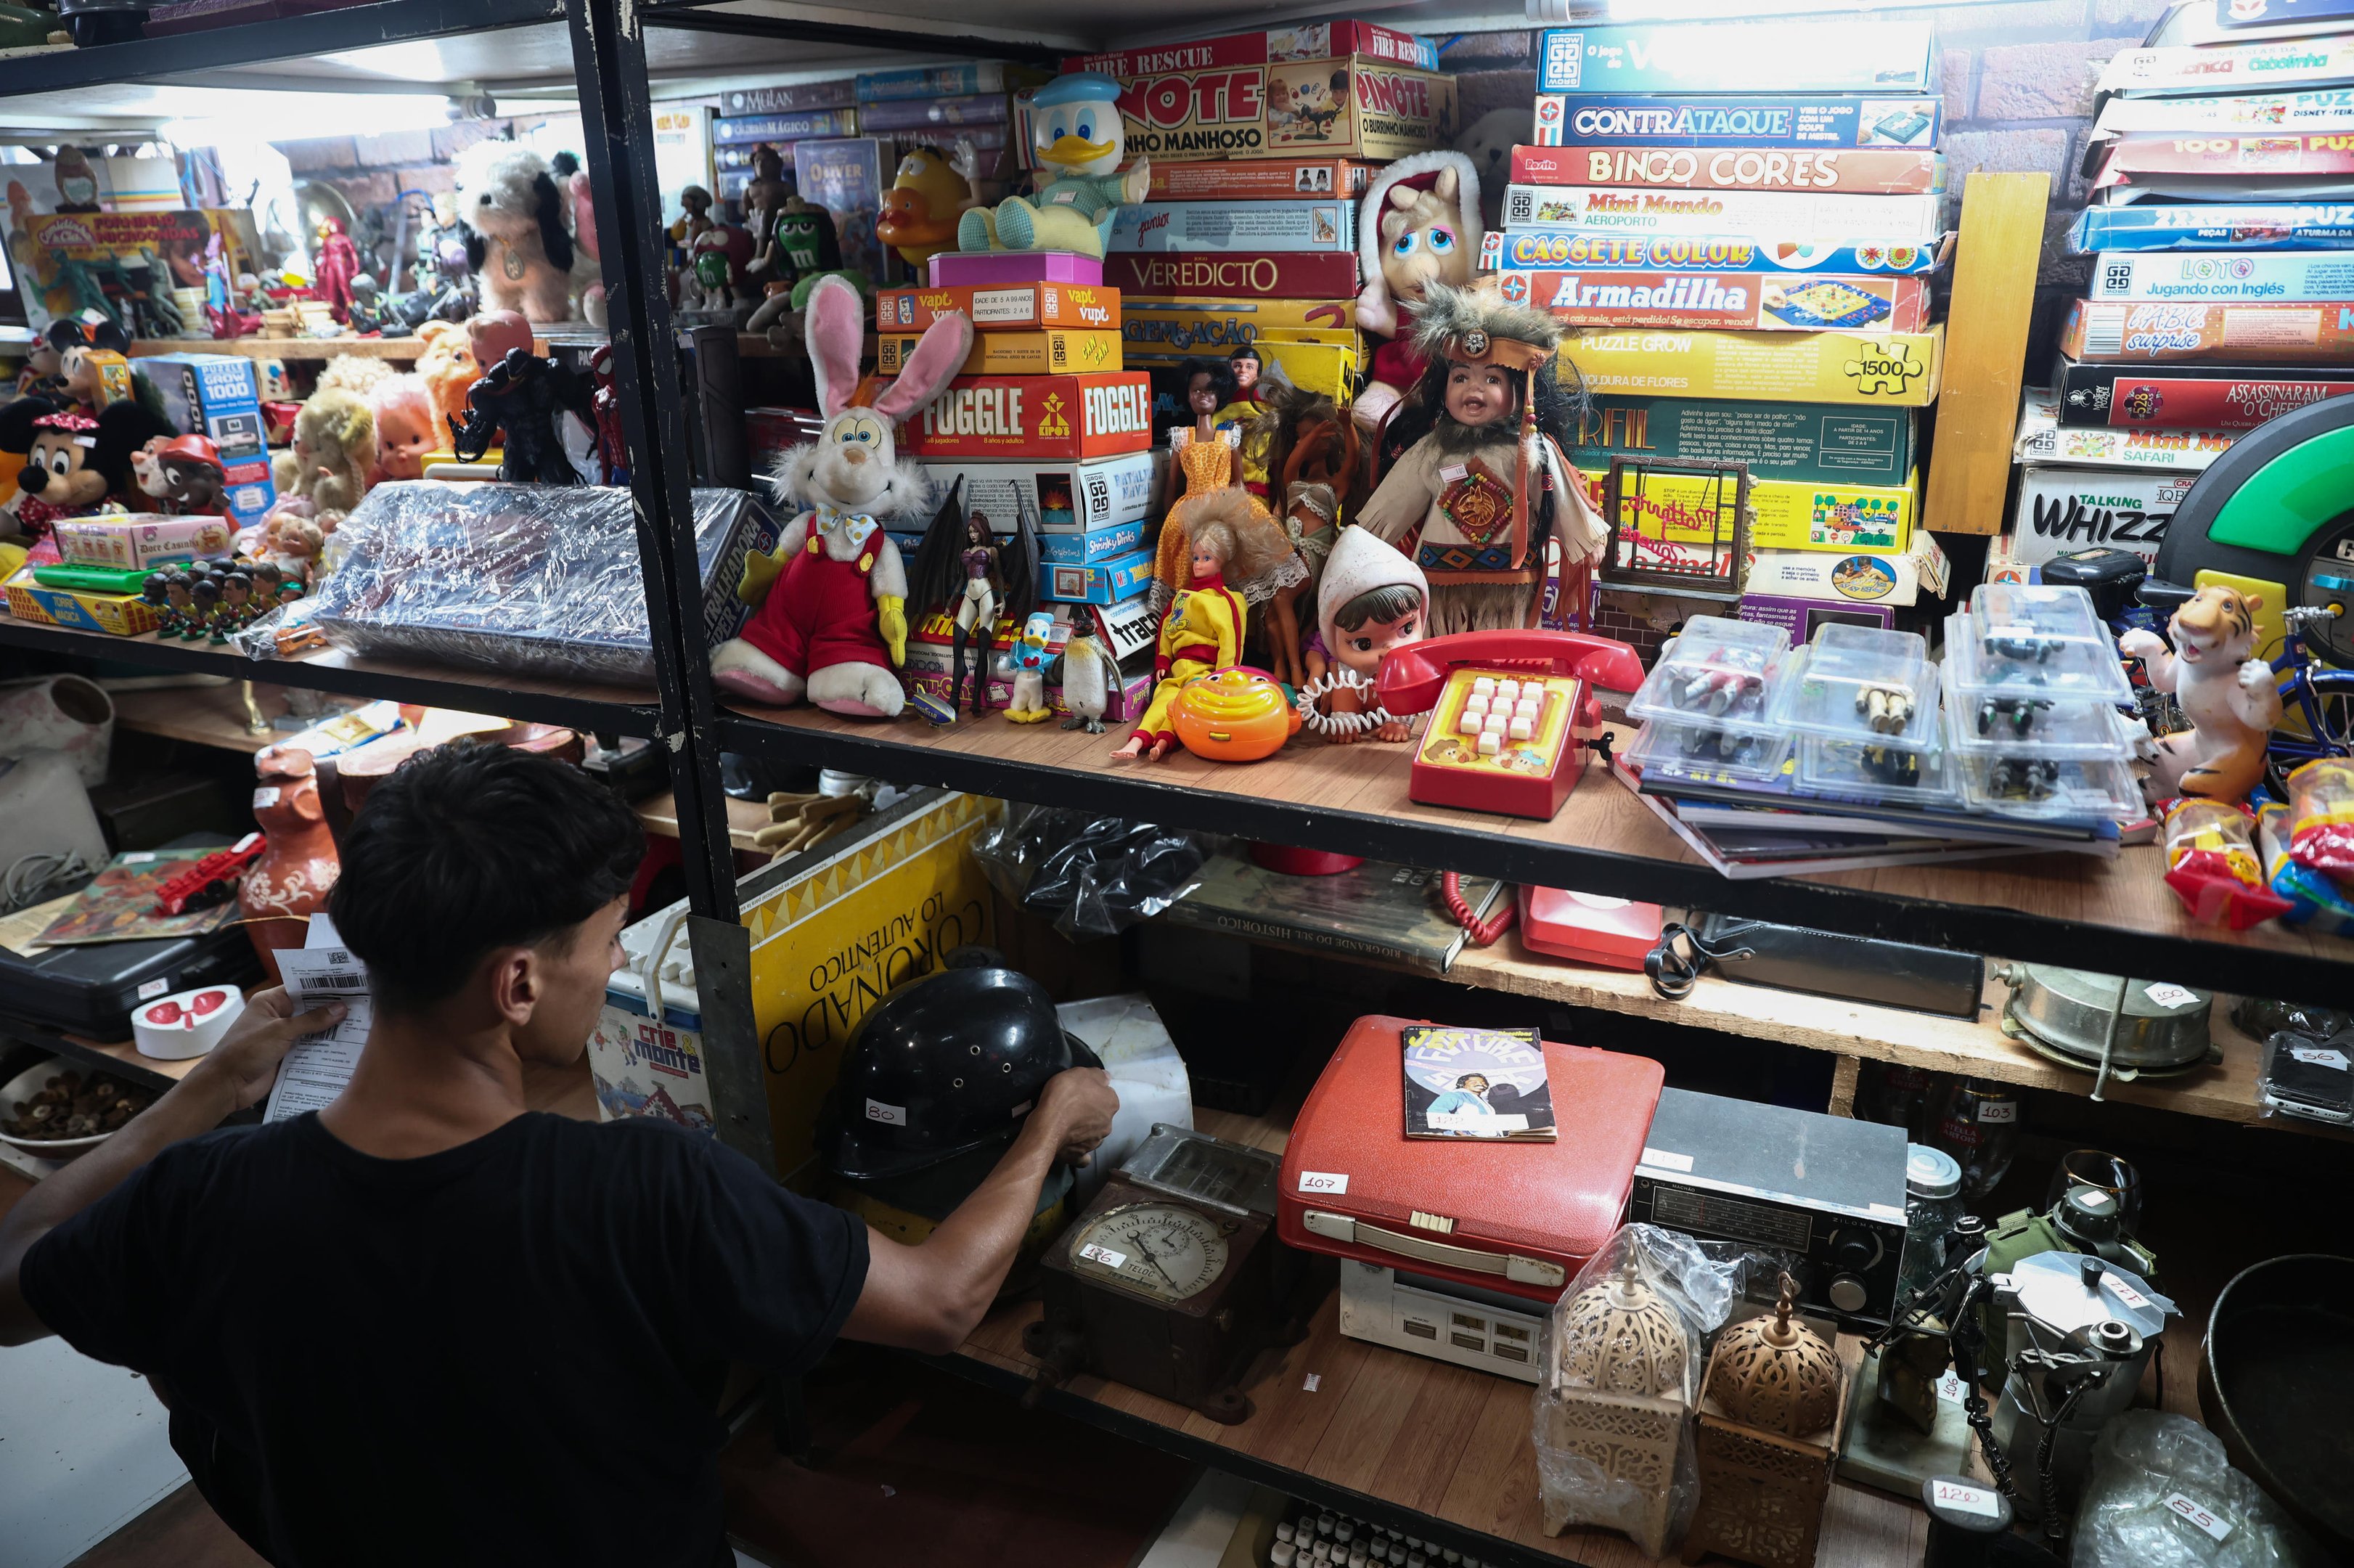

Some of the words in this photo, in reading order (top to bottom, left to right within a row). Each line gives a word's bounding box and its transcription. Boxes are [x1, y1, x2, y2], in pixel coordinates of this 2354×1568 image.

[1373, 36, 1395, 58] FIRE
[1398, 41, 1429, 65] RESCUE
[1137, 46, 1213, 73] RESCUE
[1356, 69, 1431, 121] PINOTE
[1369, 120, 1399, 136] BURRINHO
[1399, 123, 1427, 139] MANHOSO
[1165, 128, 1262, 151] MANHOSO
[1525, 160, 1556, 171] Rosita
[1587, 150, 1698, 182] BINGO
[1708, 152, 1839, 187] CORES
[1585, 193, 1639, 213] Mini
[1641, 195, 1723, 216] Mundo
[1585, 215, 1656, 226] AEROPORTO
[2199, 229, 2227, 238] PEÇAS
[1516, 238, 1643, 264] CASSETE
[1650, 239, 1754, 265] COLOR
[1129, 258, 1278, 291] VEREDICTO
[2181, 258, 2255, 279] LOTO
[1552, 277, 1746, 310] Armadilha
[2146, 282, 2208, 297] Jugando
[2211, 284, 2239, 295] con
[2241, 282, 2285, 297] Inglés
[919, 292, 952, 312] vapt
[1068, 288, 1096, 309] vapt
[1079, 306, 1109, 325] vupt
[1587, 315, 1611, 324] nela,
[1632, 315, 1669, 325] perdido!
[1670, 315, 1681, 325] Se
[1683, 317, 1722, 326] escapar,
[1724, 317, 1754, 326] vence!
[1082, 335, 1096, 360] CAN
[1094, 340, 1109, 365] CAN
[1581, 335, 1639, 351] PUZZLE
[1642, 337, 1692, 353] GROW
[2128, 332, 2199, 356] surprise
[202, 363, 243, 375] PUZZLE
[1860, 362, 1903, 376] 1500
[204, 372, 245, 385] GROW
[1632, 376, 1646, 386] DE
[1647, 377, 1688, 388] FLORES
[205, 383, 249, 399] 1000
[2101, 385, 2110, 409] PUZZLE
[183, 371, 203, 433] 1000
[1084, 384, 1149, 436] FOGGLE
[2133, 392, 2149, 415] 528
[923, 388, 1025, 436] FOGGLE
[1039, 425, 1070, 436] KIPO'S
[2124, 429, 2189, 450] Mini
[2123, 451, 2175, 462] SAFARI
[2080, 494, 2143, 509] TALKING
[1092, 513, 1110, 522] GROW
[139, 544, 161, 553] Doce
[1089, 536, 1116, 555] Shrinky
[1116, 533, 1135, 547] Dinks
[1087, 569, 1095, 580] 3
[1115, 572, 1128, 587] MB
[52, 596, 74, 609] TORRE
[922, 891, 943, 922] LO
[1295, 930, 1314, 941] SUL
[1316, 934, 1333, 945] DO
[1335, 938, 1380, 954] GRANDE
[1381, 947, 1401, 958] RIO
[2157, 989, 2183, 1001] 100
[638, 1023, 677, 1050] crie
[1408, 1030, 1466, 1049] JET
[867, 1106, 894, 1120] 80
[1982, 1107, 2011, 1119] 103
[1944, 1131, 1976, 1143] ARTOIS
[1945, 1122, 1977, 1137] STELLA
[1304, 1177, 1336, 1189] 107
[1831, 1217, 1882, 1231] ZILOMAG
[1127, 1264, 1156, 1278] TELOC
[1943, 1378, 1958, 1397] 106
[2173, 1499, 2215, 1527] 85
